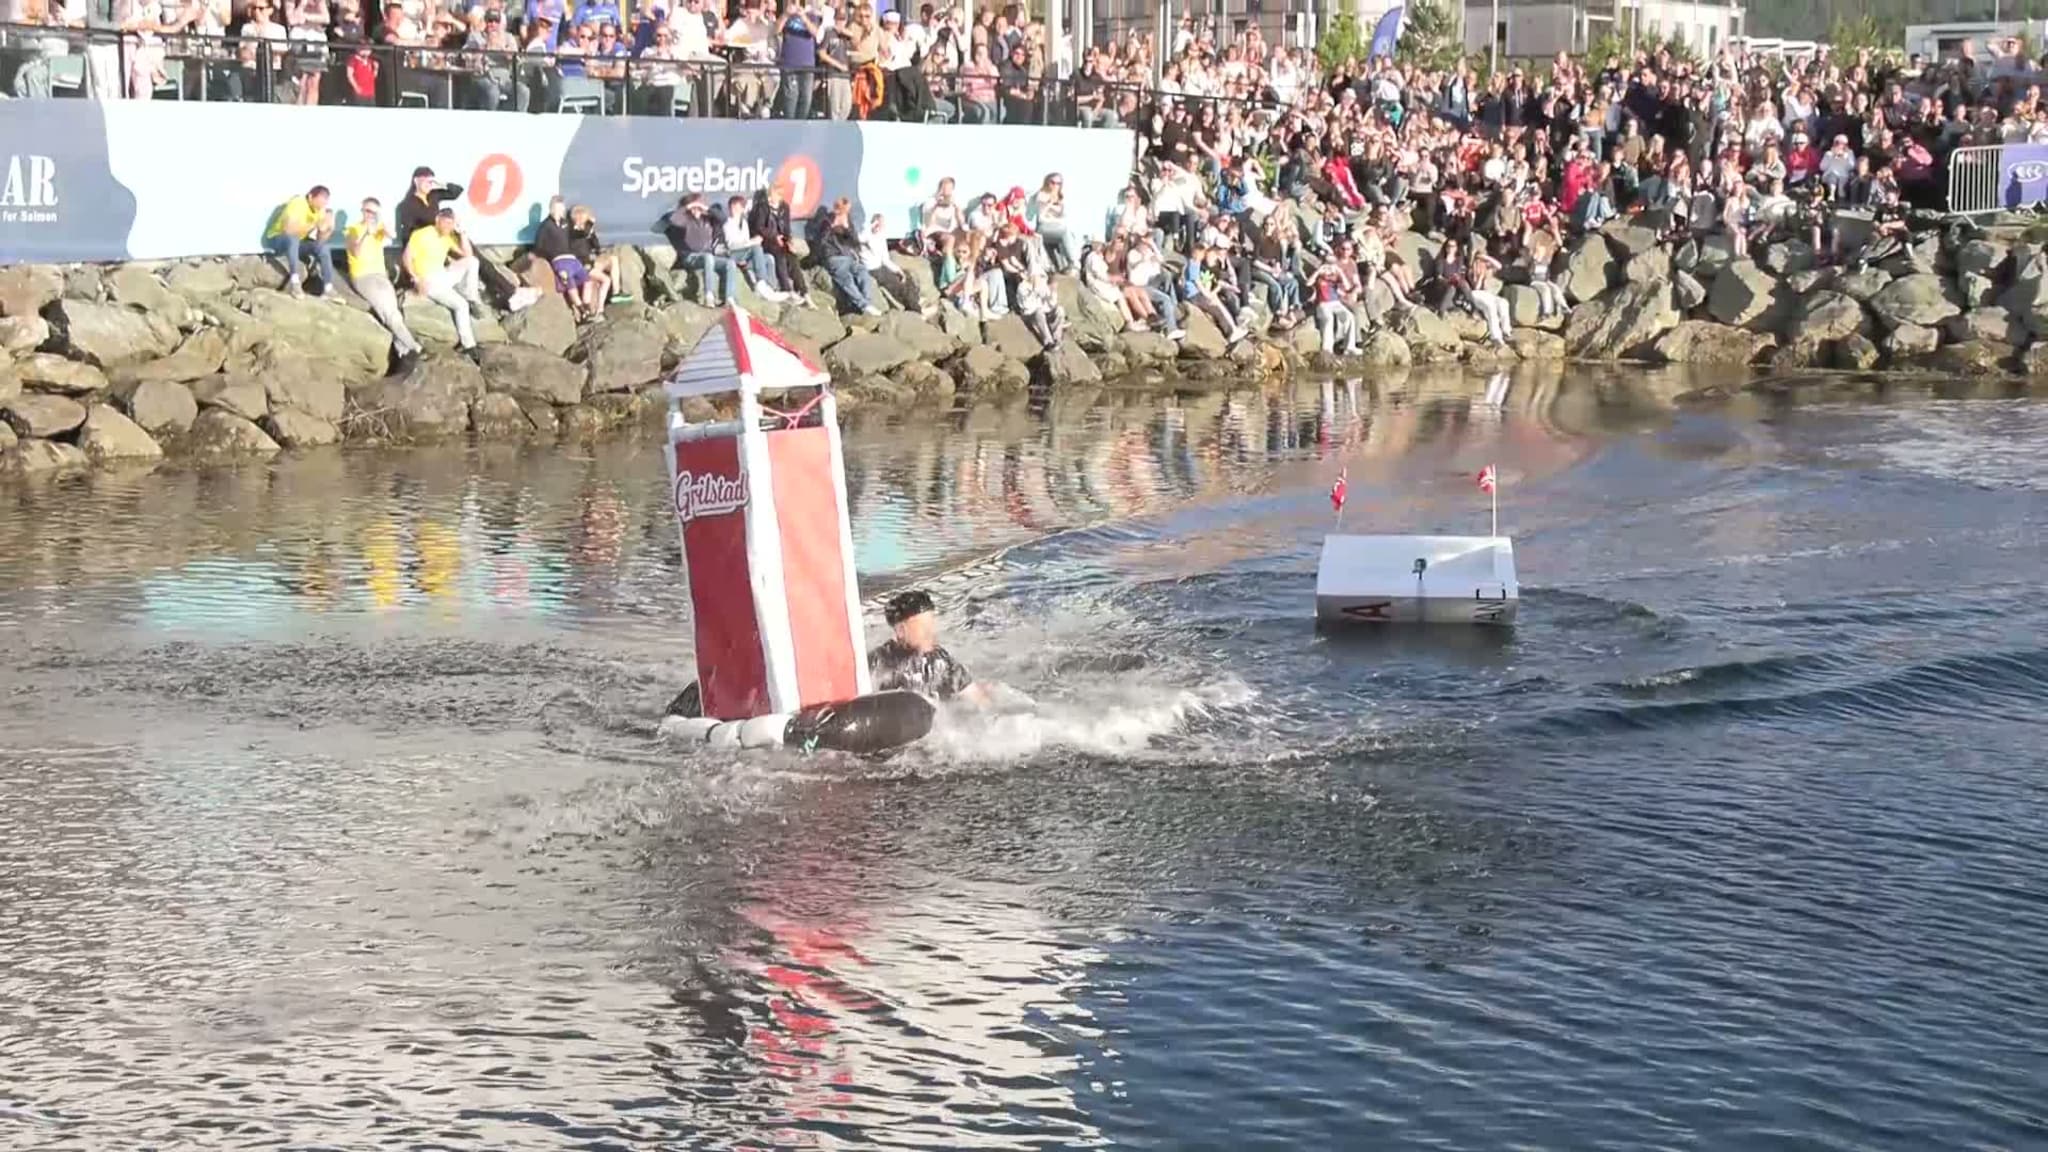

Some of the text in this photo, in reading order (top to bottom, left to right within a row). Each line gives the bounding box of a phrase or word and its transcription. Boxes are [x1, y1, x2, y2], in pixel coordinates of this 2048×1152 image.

[486, 165, 506, 205] 1
[622, 156, 807, 206] SpareBank 1
[20, 210, 57, 222] Salmon
[675, 470, 749, 521] Grilstad
